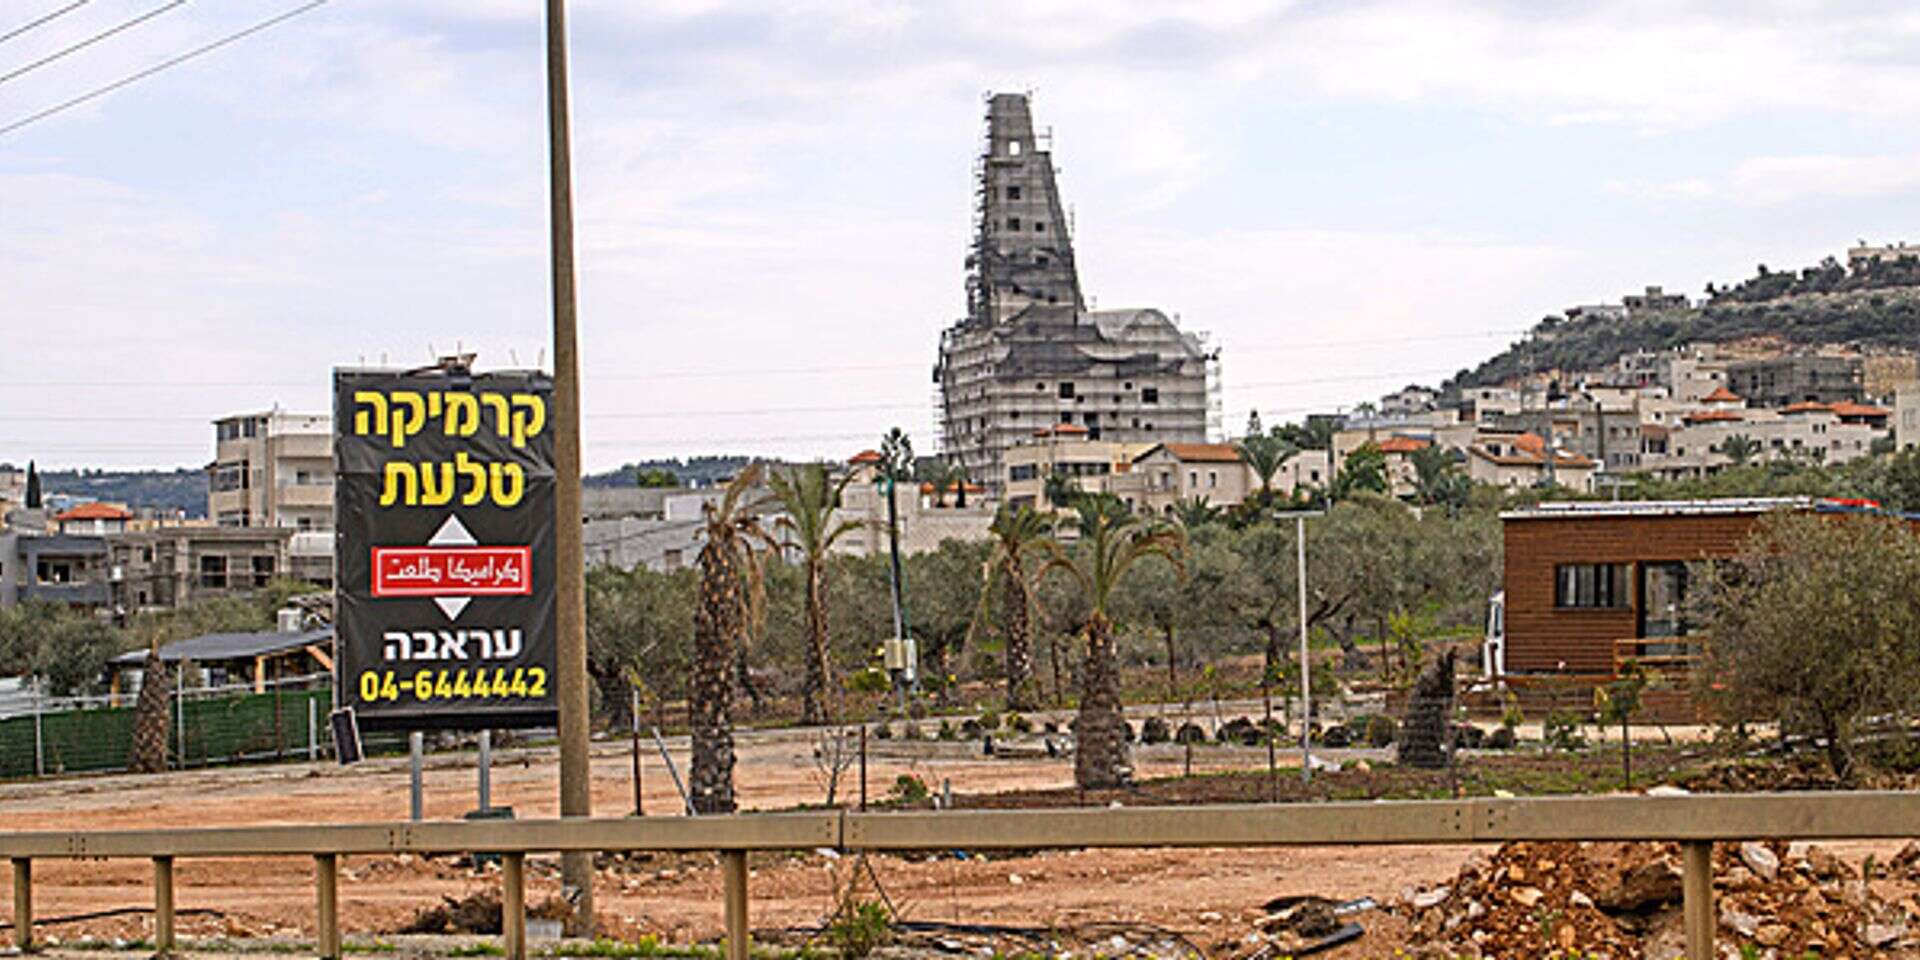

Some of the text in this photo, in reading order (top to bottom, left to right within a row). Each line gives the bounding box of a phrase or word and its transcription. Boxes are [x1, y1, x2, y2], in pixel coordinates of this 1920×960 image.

[354, 391, 546, 448] קרמיקה
[379, 452, 525, 506] טלעת
[383, 628, 522, 660] עראבה
[360, 667, 546, 701] 04-6444442
